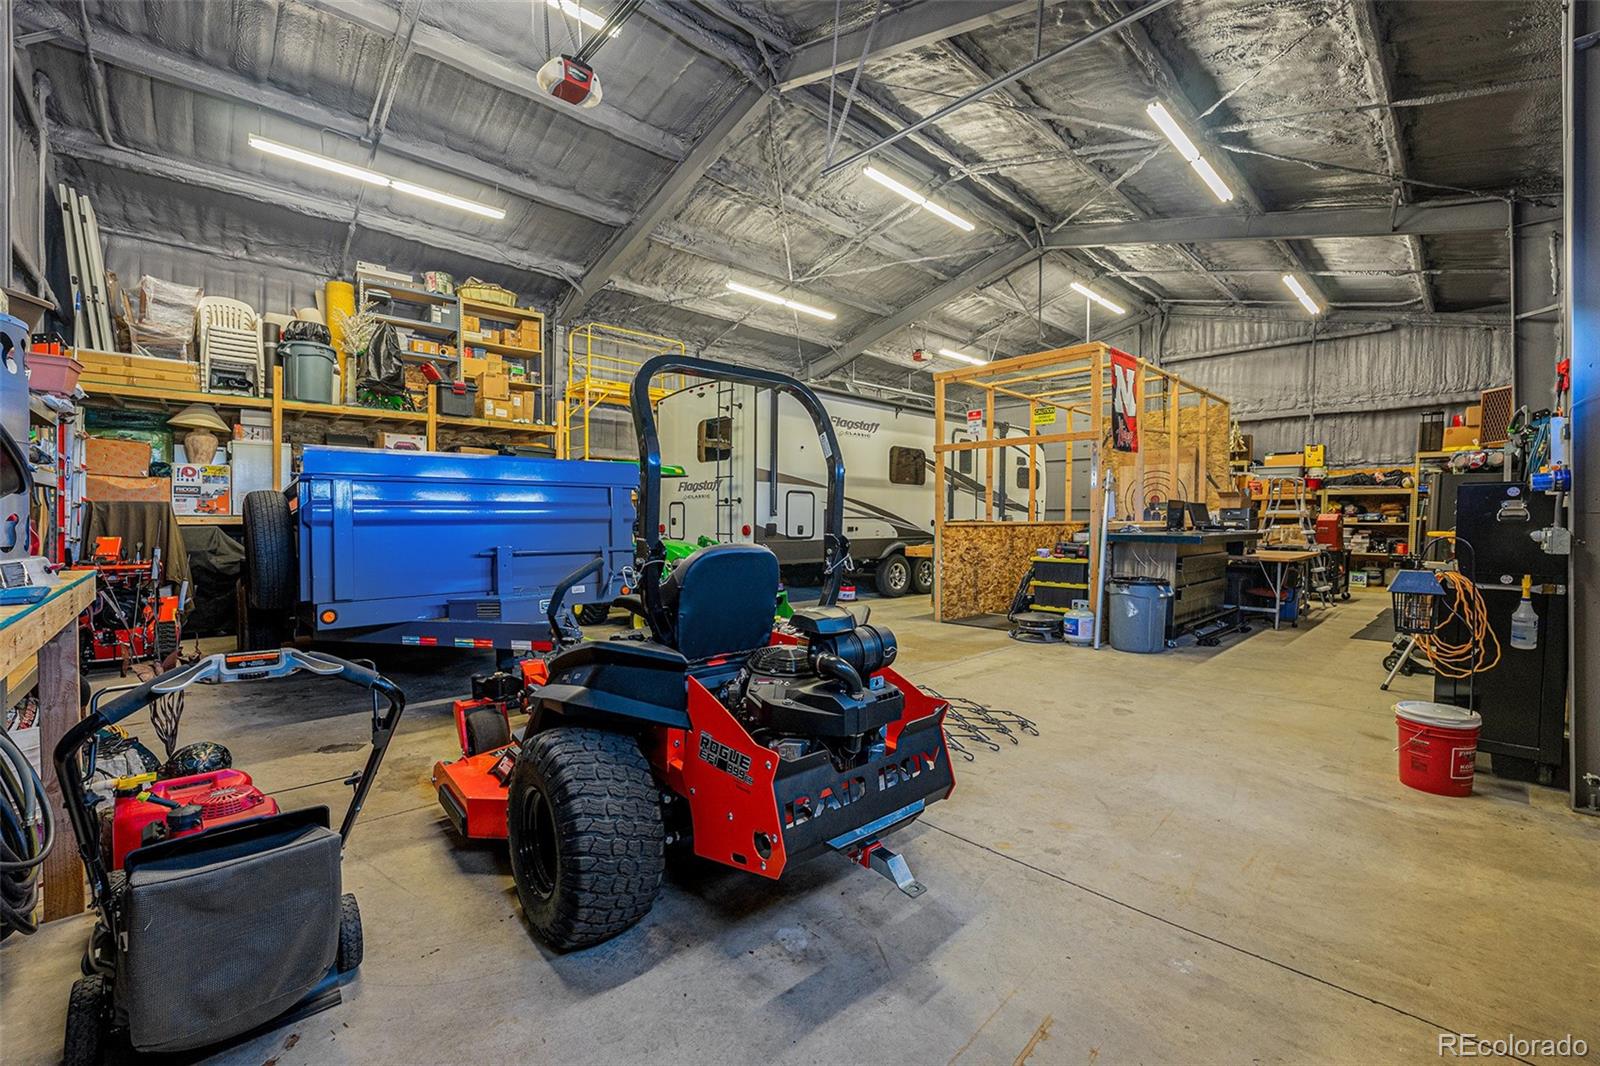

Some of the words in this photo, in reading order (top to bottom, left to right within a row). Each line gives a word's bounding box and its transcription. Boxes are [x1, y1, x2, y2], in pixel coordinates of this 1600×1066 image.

[1114, 364, 1137, 416] N
[830, 415, 880, 433] Flagstaff
[678, 480, 724, 492] Flagstaff
[700, 735, 752, 770] ROGUE
[784, 776, 866, 830] BAD
[877, 746, 941, 792] BOY
